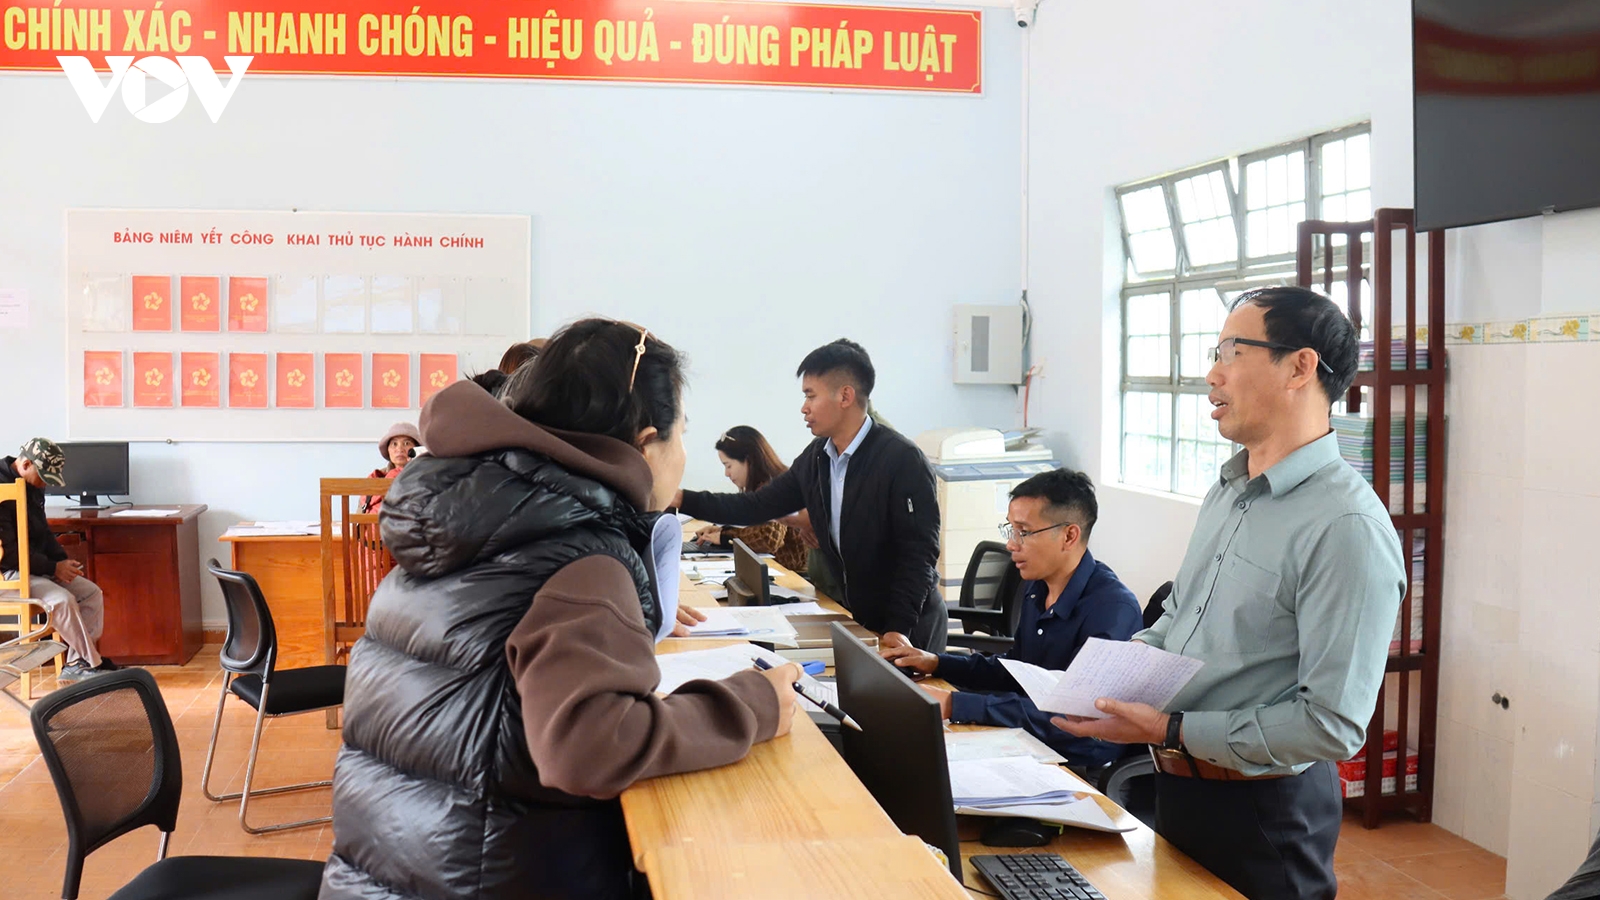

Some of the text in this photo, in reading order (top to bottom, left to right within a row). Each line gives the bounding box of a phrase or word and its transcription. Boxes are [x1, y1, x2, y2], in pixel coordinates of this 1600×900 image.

[4, 0, 111, 52] CHÍNH
[123, 1, 192, 53] XÁC
[228, 11, 346, 55] NHANH
[358, 6, 473, 58] CHÓNG
[508, 9, 583, 69] HIỆU
[594, 7, 660, 66] QUẢ
[692, 16, 780, 66] ĐÚNG
[791, 20, 873, 71] PHÁP
[884, 25, 957, 81] LUẬT
[113, 227, 484, 250] BẢNG NIÊM YẾT CÔNG KHAI THỦ TỤC HÀNH CHÍNH
